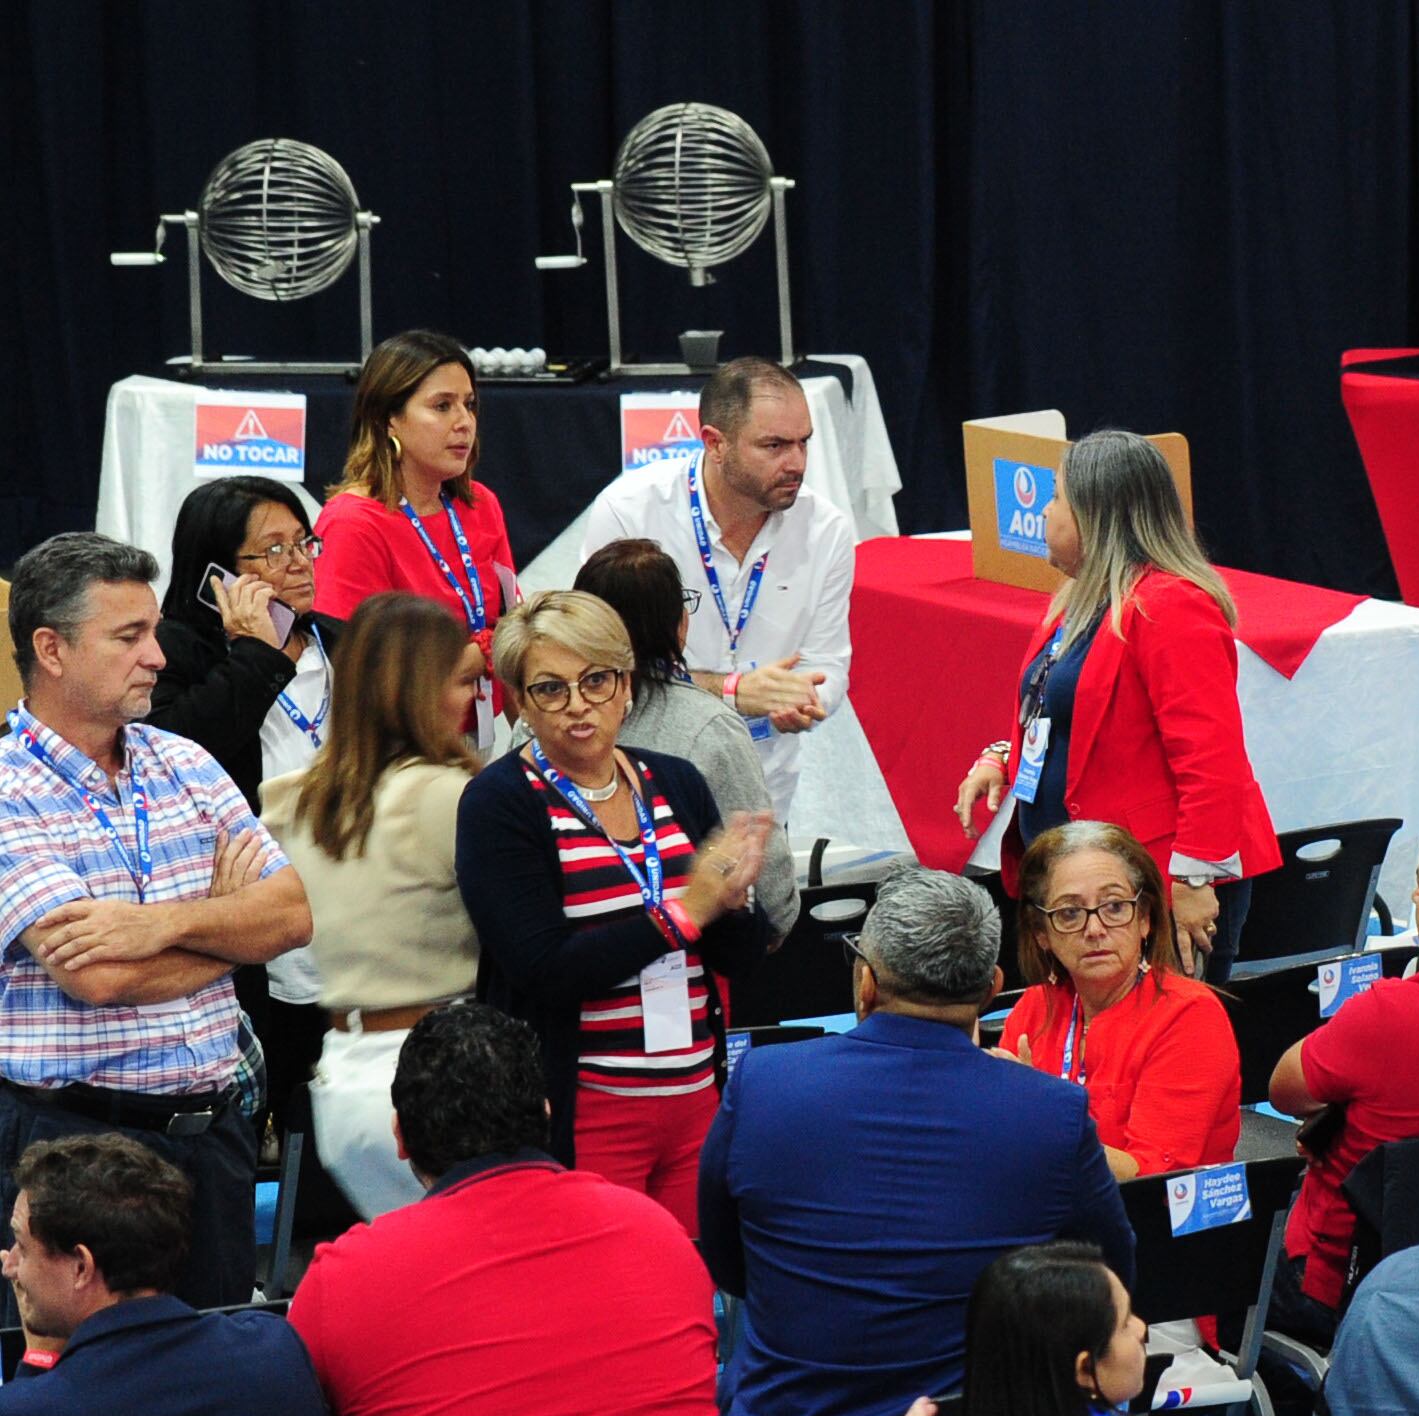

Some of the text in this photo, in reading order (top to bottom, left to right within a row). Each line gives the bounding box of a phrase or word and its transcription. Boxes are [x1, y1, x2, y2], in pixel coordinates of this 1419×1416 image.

[203, 444, 299, 464] NO TOCAR
[633, 448, 660, 465] NO
[1009, 509, 1045, 538] A01
[649, 867, 663, 903] UNIDAD
[1202, 1183, 1242, 1200] Sánchez
[1209, 1194, 1243, 1208] Vargas
